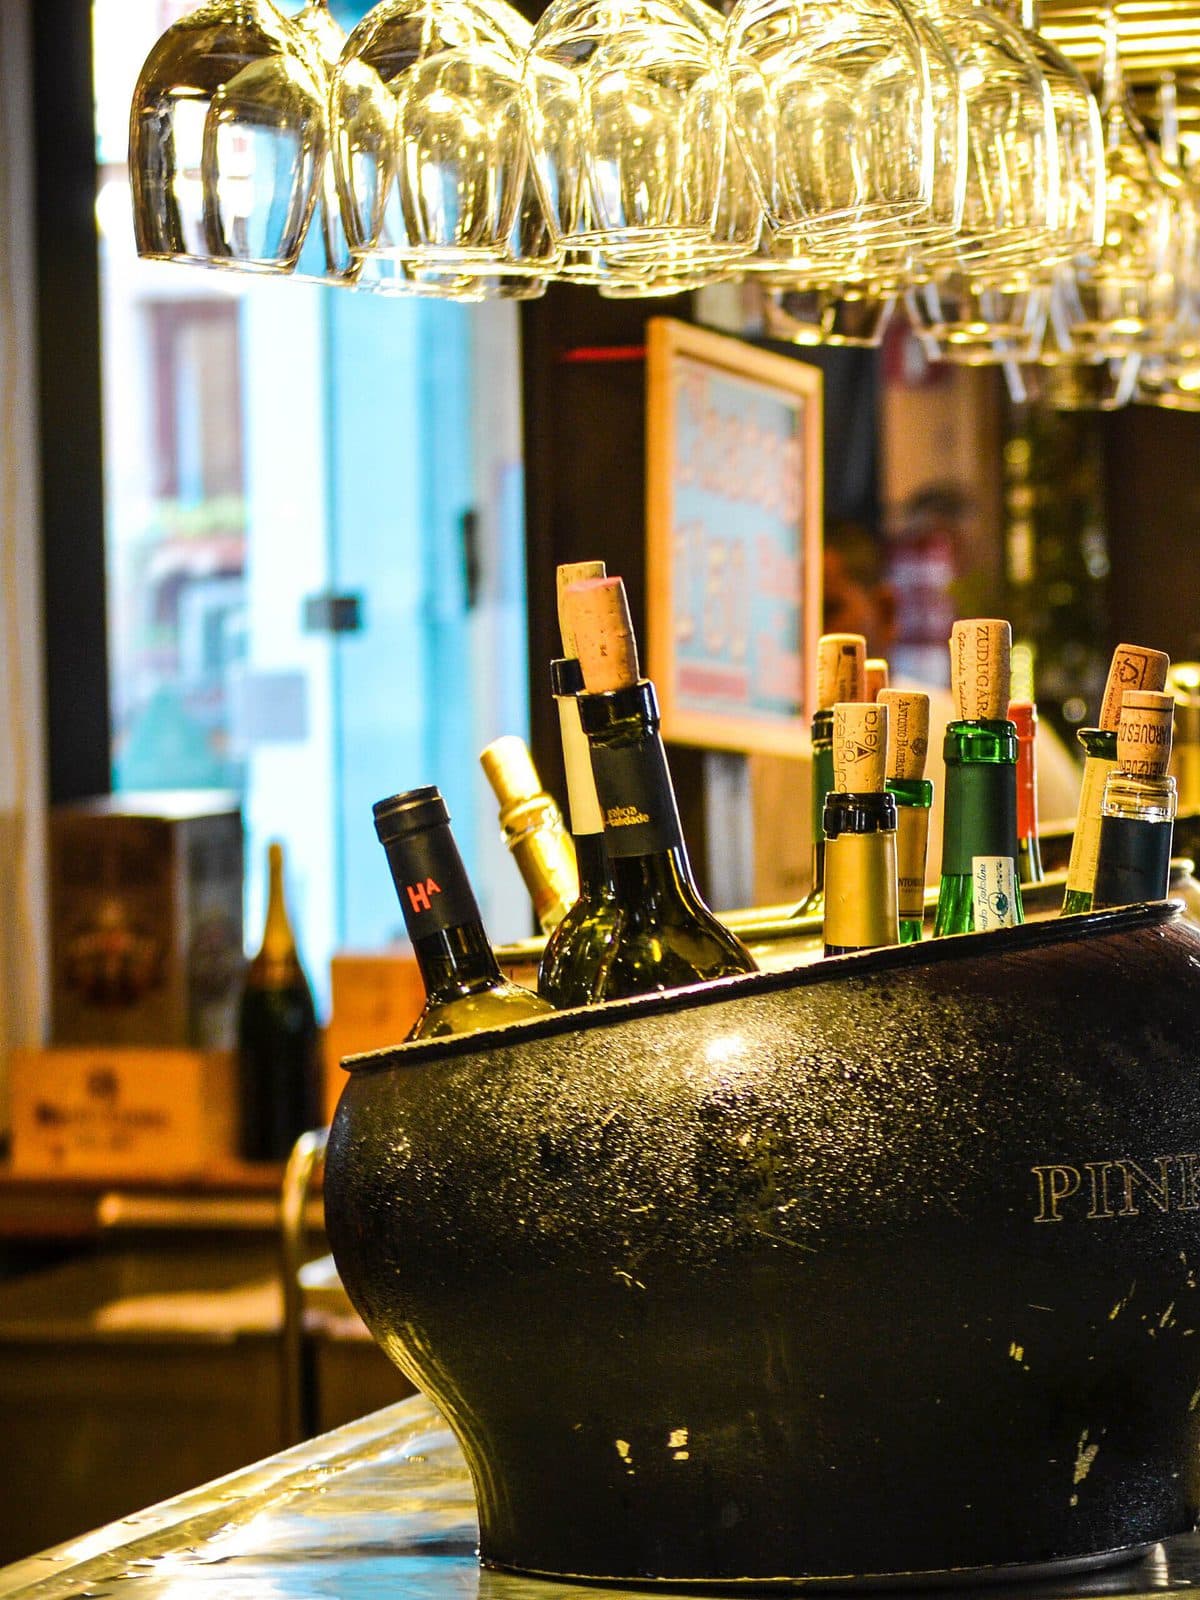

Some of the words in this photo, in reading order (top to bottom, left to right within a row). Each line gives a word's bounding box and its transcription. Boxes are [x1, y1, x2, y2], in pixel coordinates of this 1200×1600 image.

[853, 710, 878, 764] Vera
[1128, 723, 1169, 746] ARQUES
[844, 739, 856, 763] de
[406, 877, 442, 913] HA
